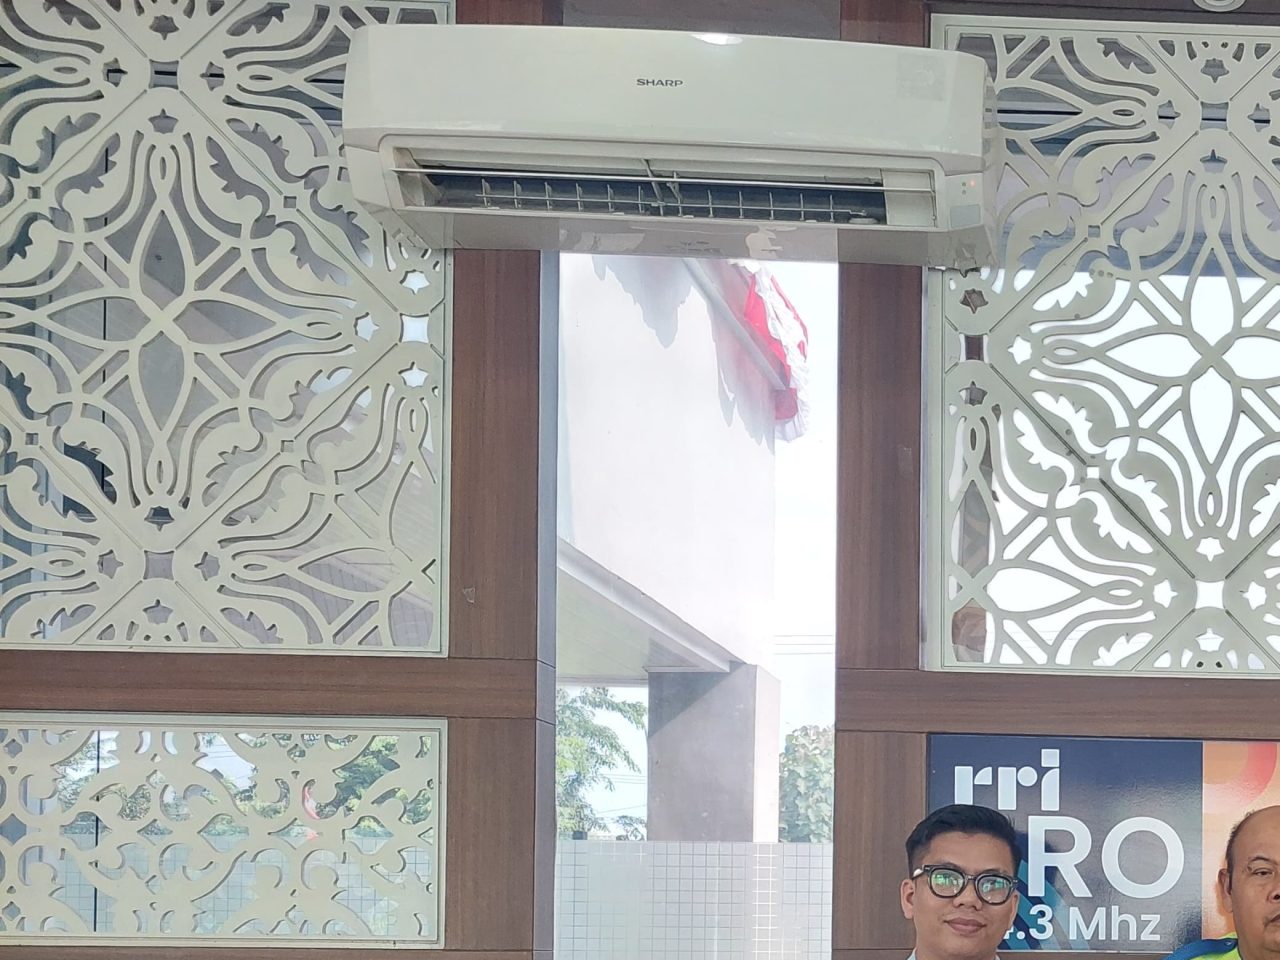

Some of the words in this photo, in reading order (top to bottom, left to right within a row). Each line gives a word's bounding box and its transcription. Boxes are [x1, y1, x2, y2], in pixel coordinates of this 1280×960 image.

[636, 78, 684, 87] SHARP
[954, 748, 1060, 811] rri
[1069, 905, 1162, 941] Mhz
